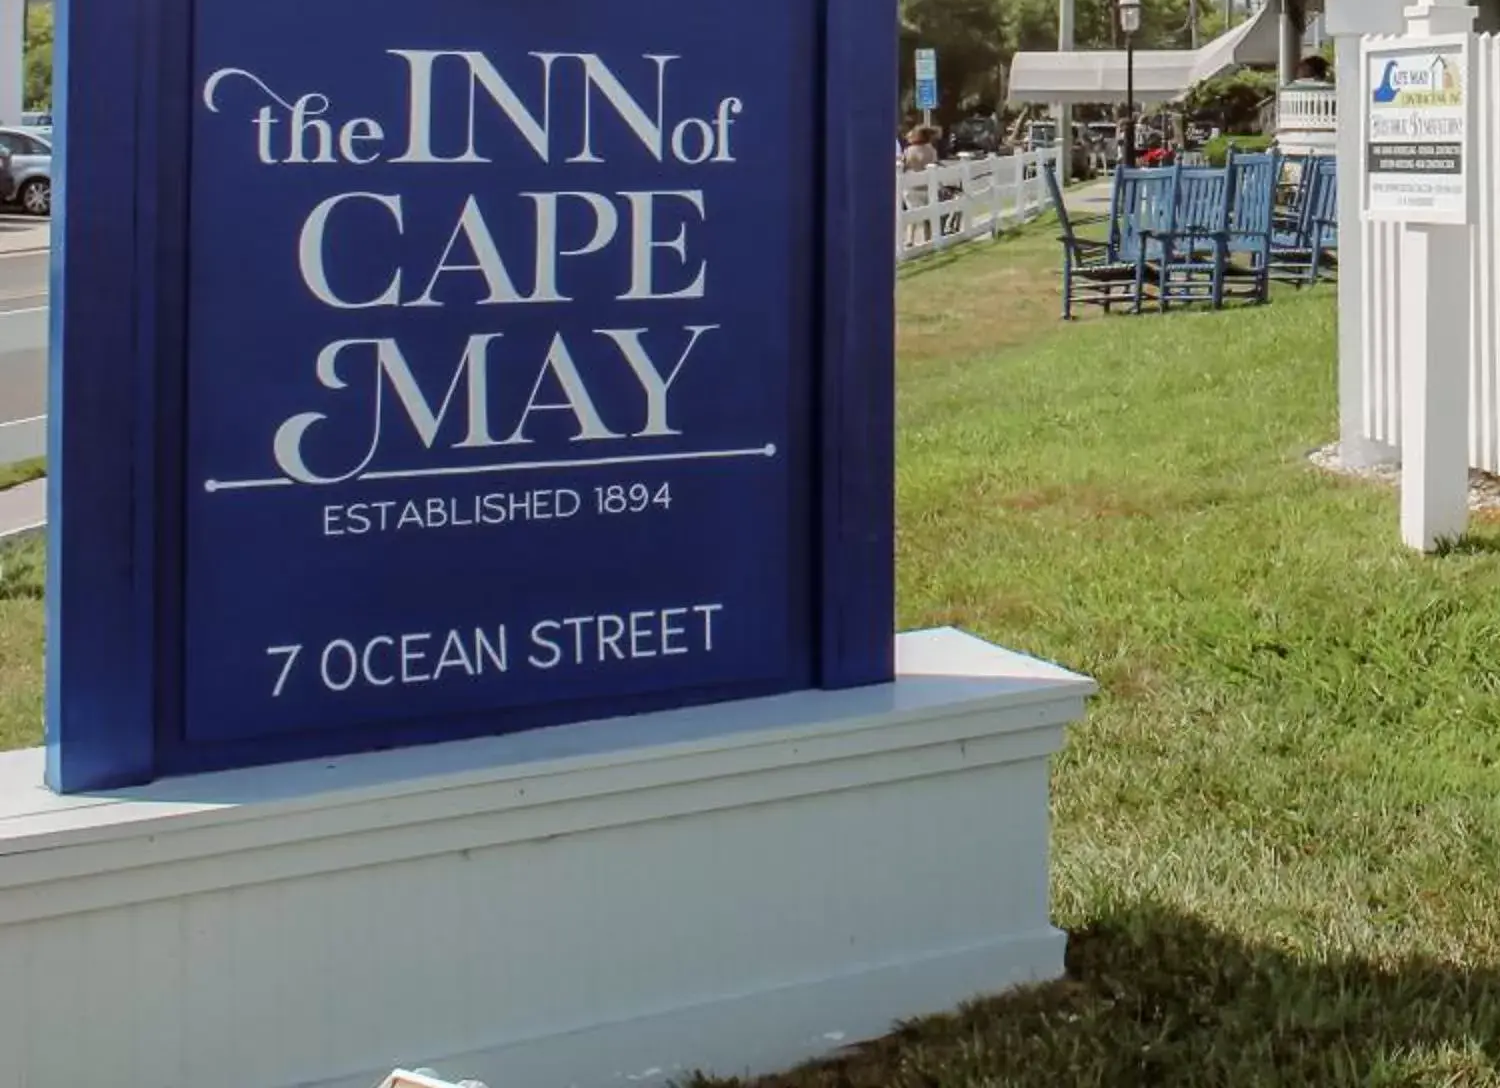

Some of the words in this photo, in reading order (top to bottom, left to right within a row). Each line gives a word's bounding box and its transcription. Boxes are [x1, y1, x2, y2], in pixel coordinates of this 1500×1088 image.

[204, 67, 385, 165] the
[386, 49, 681, 164] INN
[671, 96, 743, 164] of
[299, 190, 707, 309] CAPE
[273, 324, 720, 485] MAY
[323, 488, 581, 536] ESTABLISHED
[593, 482, 673, 515] 1894
[266, 644, 302, 697] 7
[321, 624, 508, 692] OCEAN
[528, 603, 723, 669] STREET
